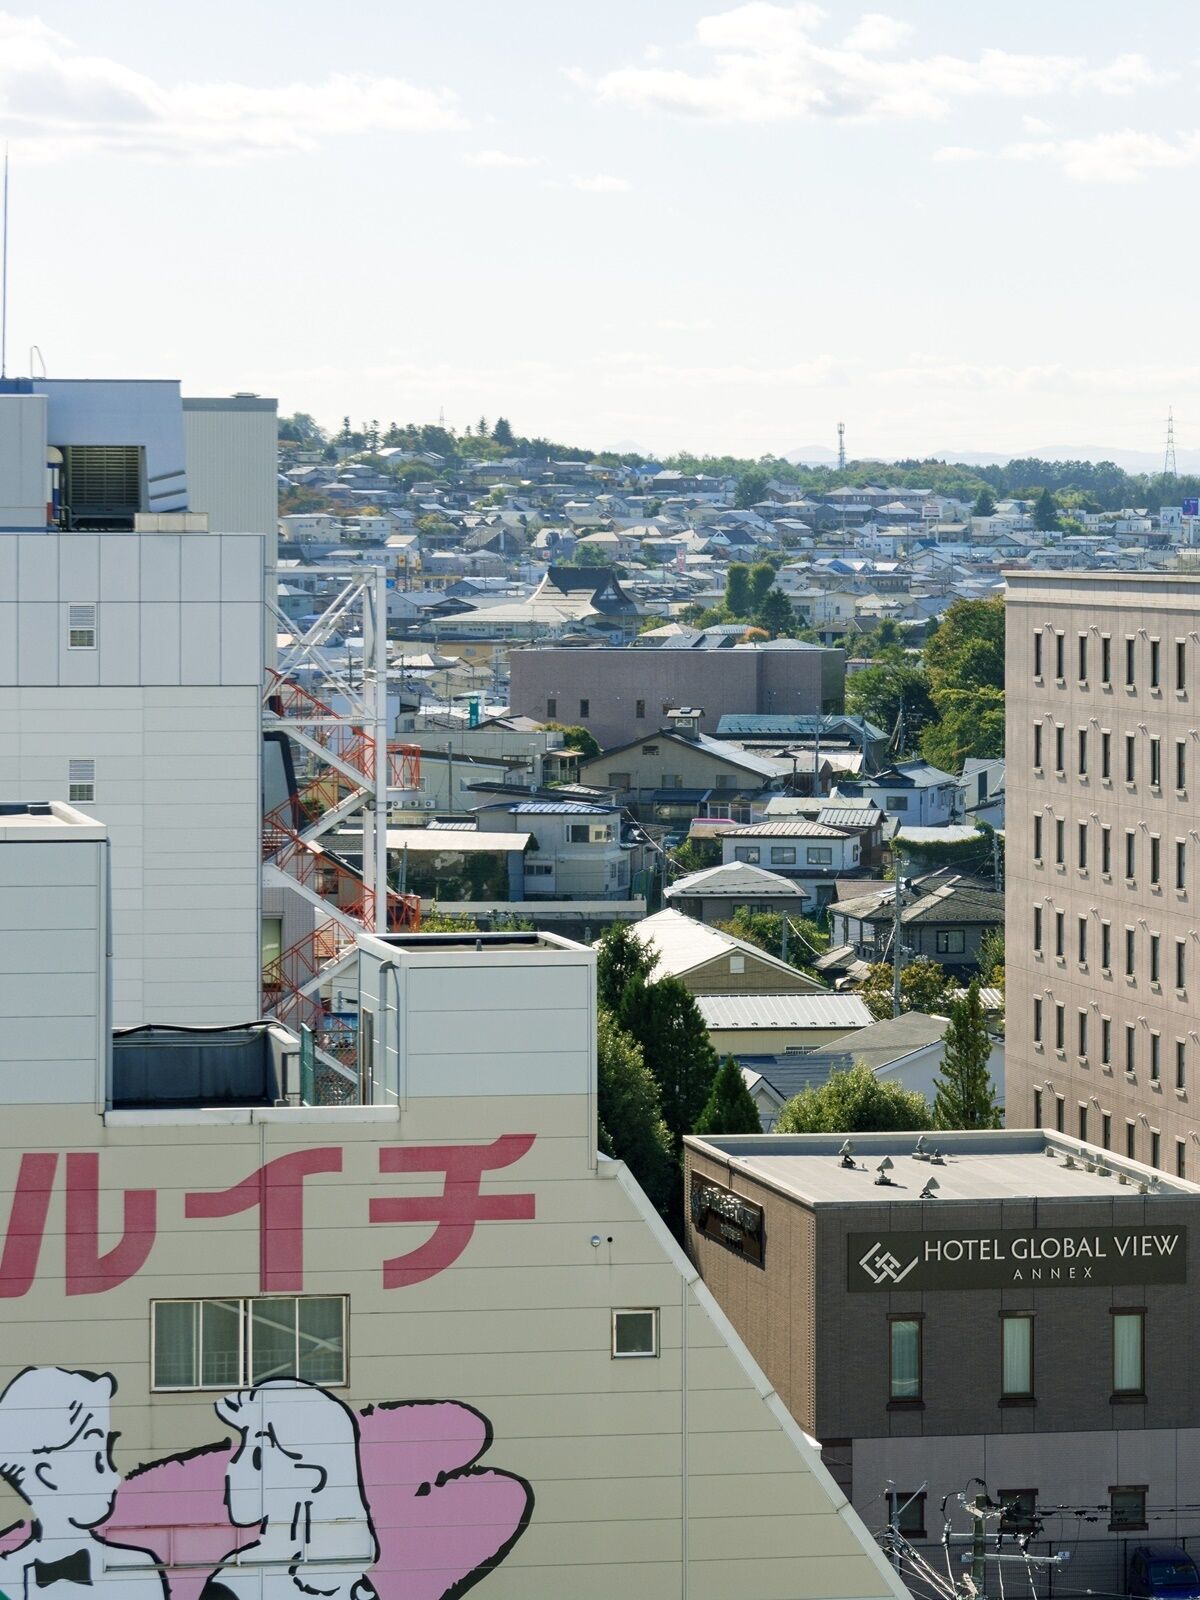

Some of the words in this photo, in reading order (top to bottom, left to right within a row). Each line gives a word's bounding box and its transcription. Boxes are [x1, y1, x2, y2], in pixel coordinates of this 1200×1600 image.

[0, 1133, 537, 1299] ルイチ
[924, 1239, 1006, 1262] HOTEL
[1011, 1236, 1107, 1260] GLOBAL
[1113, 1234, 1180, 1257] VIEW
[1013, 1266, 1093, 1281] ANNEX
